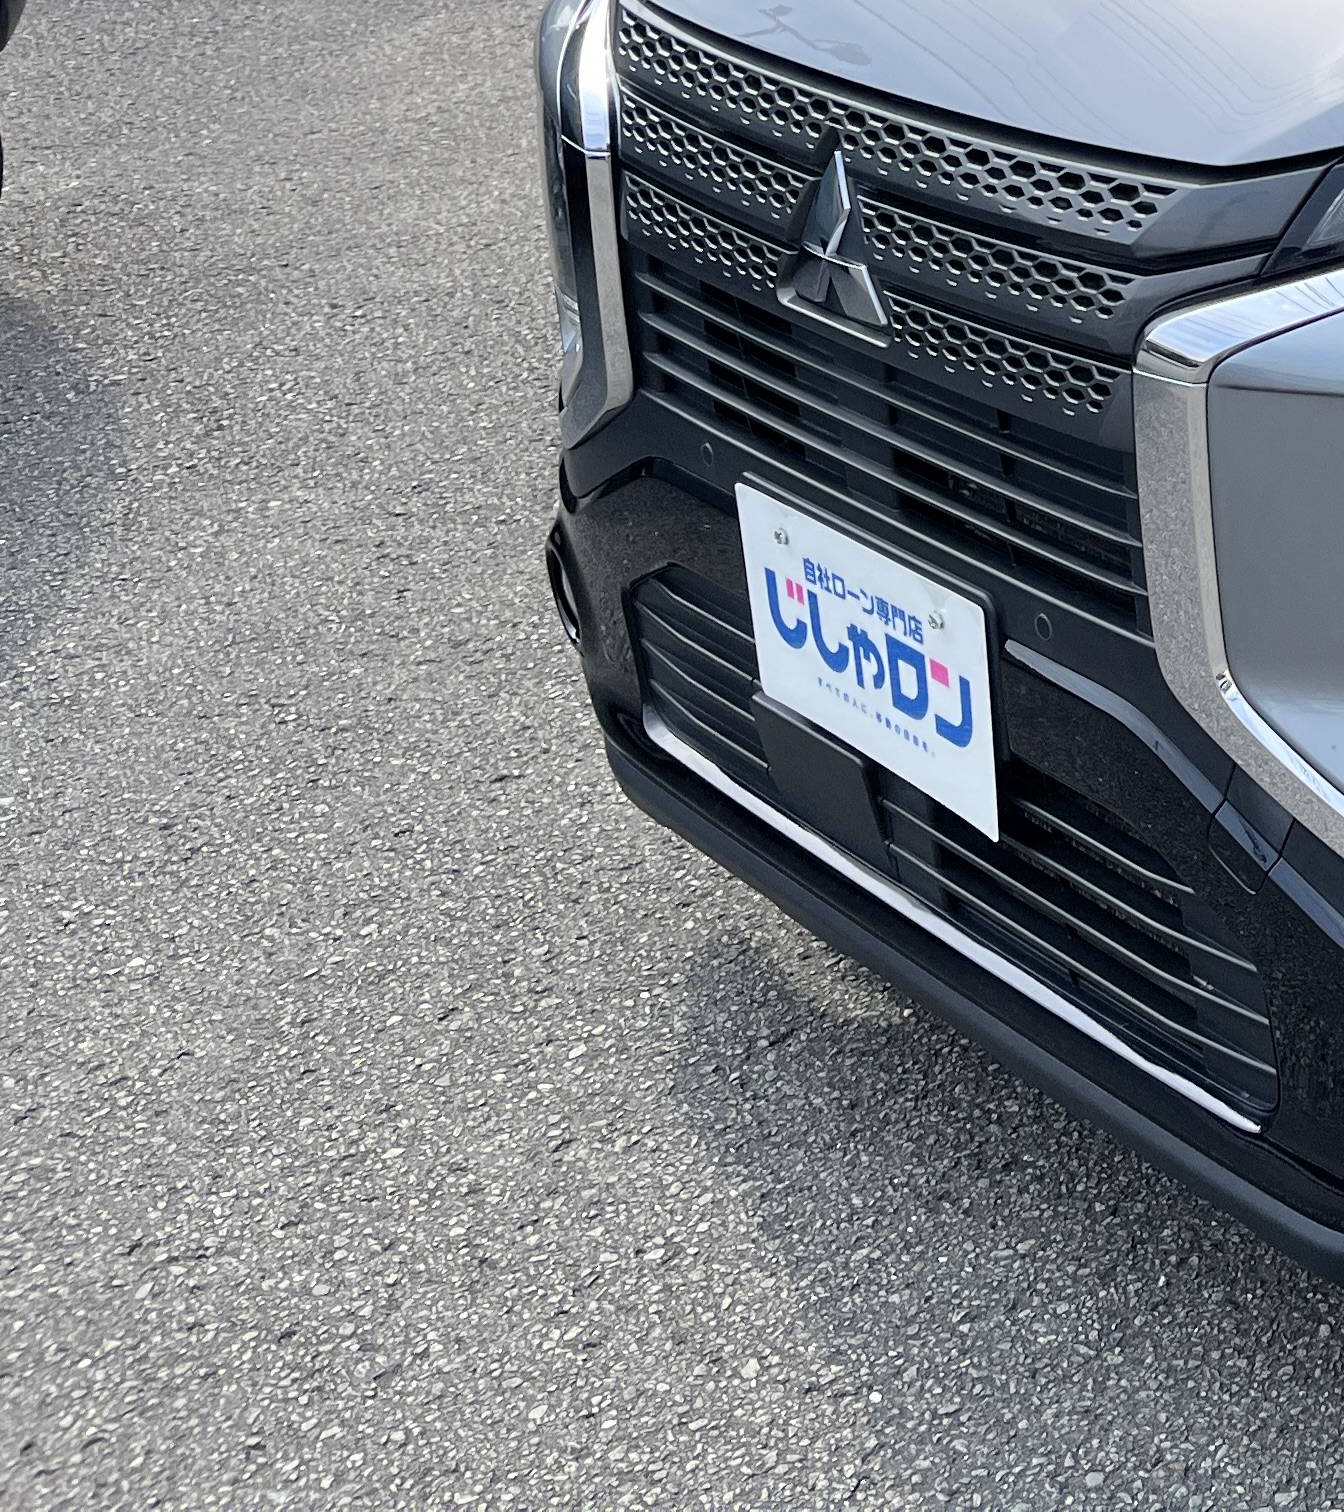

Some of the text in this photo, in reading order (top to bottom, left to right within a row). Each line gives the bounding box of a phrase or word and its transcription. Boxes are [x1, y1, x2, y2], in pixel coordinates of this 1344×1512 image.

[803, 557, 924, 645] 自社ローン専門店
